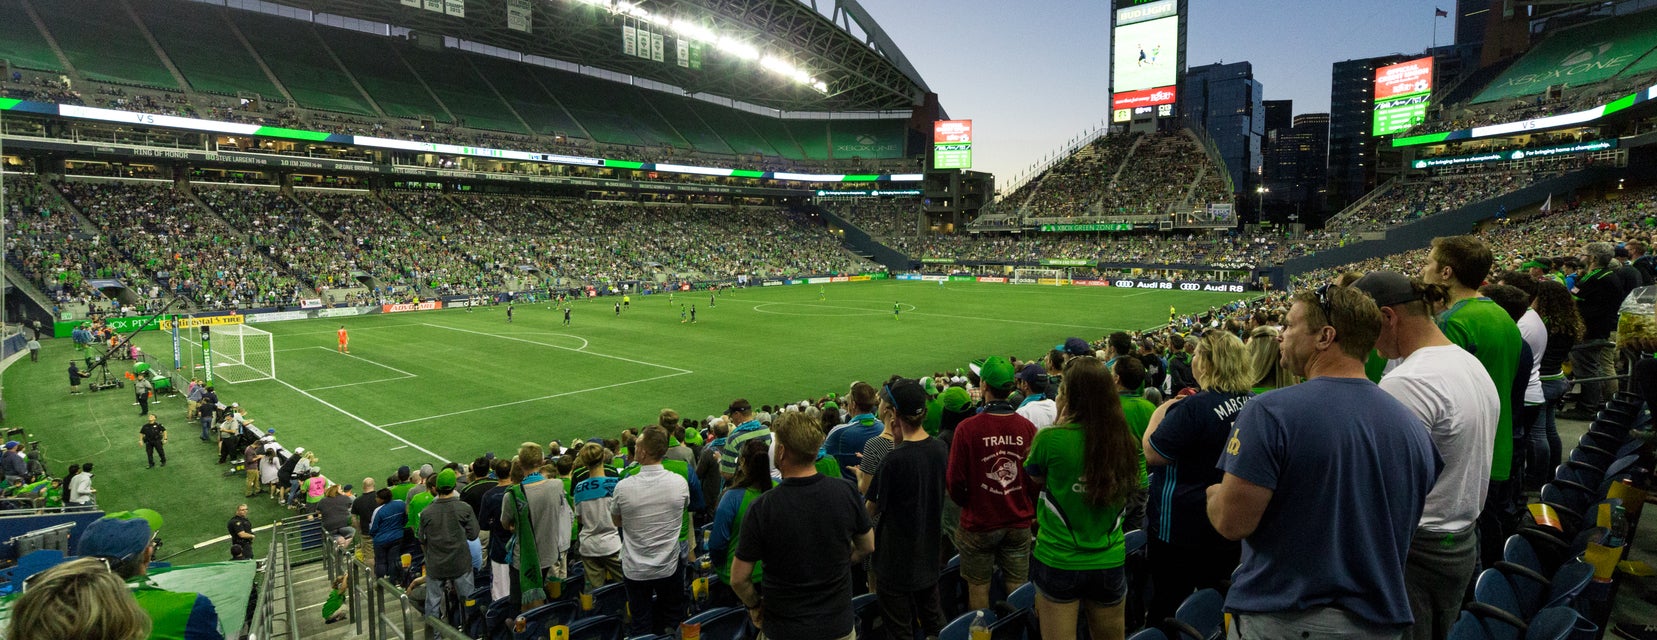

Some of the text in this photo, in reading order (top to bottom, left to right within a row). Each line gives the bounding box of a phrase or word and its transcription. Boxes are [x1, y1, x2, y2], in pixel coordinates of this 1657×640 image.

[1121, 3, 1172, 20] BUD LIGHT
[1567, 54, 1633, 76] ONE
[134, 148, 152, 156] RING
[164, 150, 189, 159] HONOR
[1535, 147, 1556, 155] bringing
[1137, 281, 1158, 289] Audi
[1204, 284, 1244, 293] Audi R8
[391, 302, 434, 312] ADVOARE
[162, 317, 214, 329] Cotinental
[1213, 395, 1252, 421] MARSH
[982, 435, 1024, 447] TRAILS
